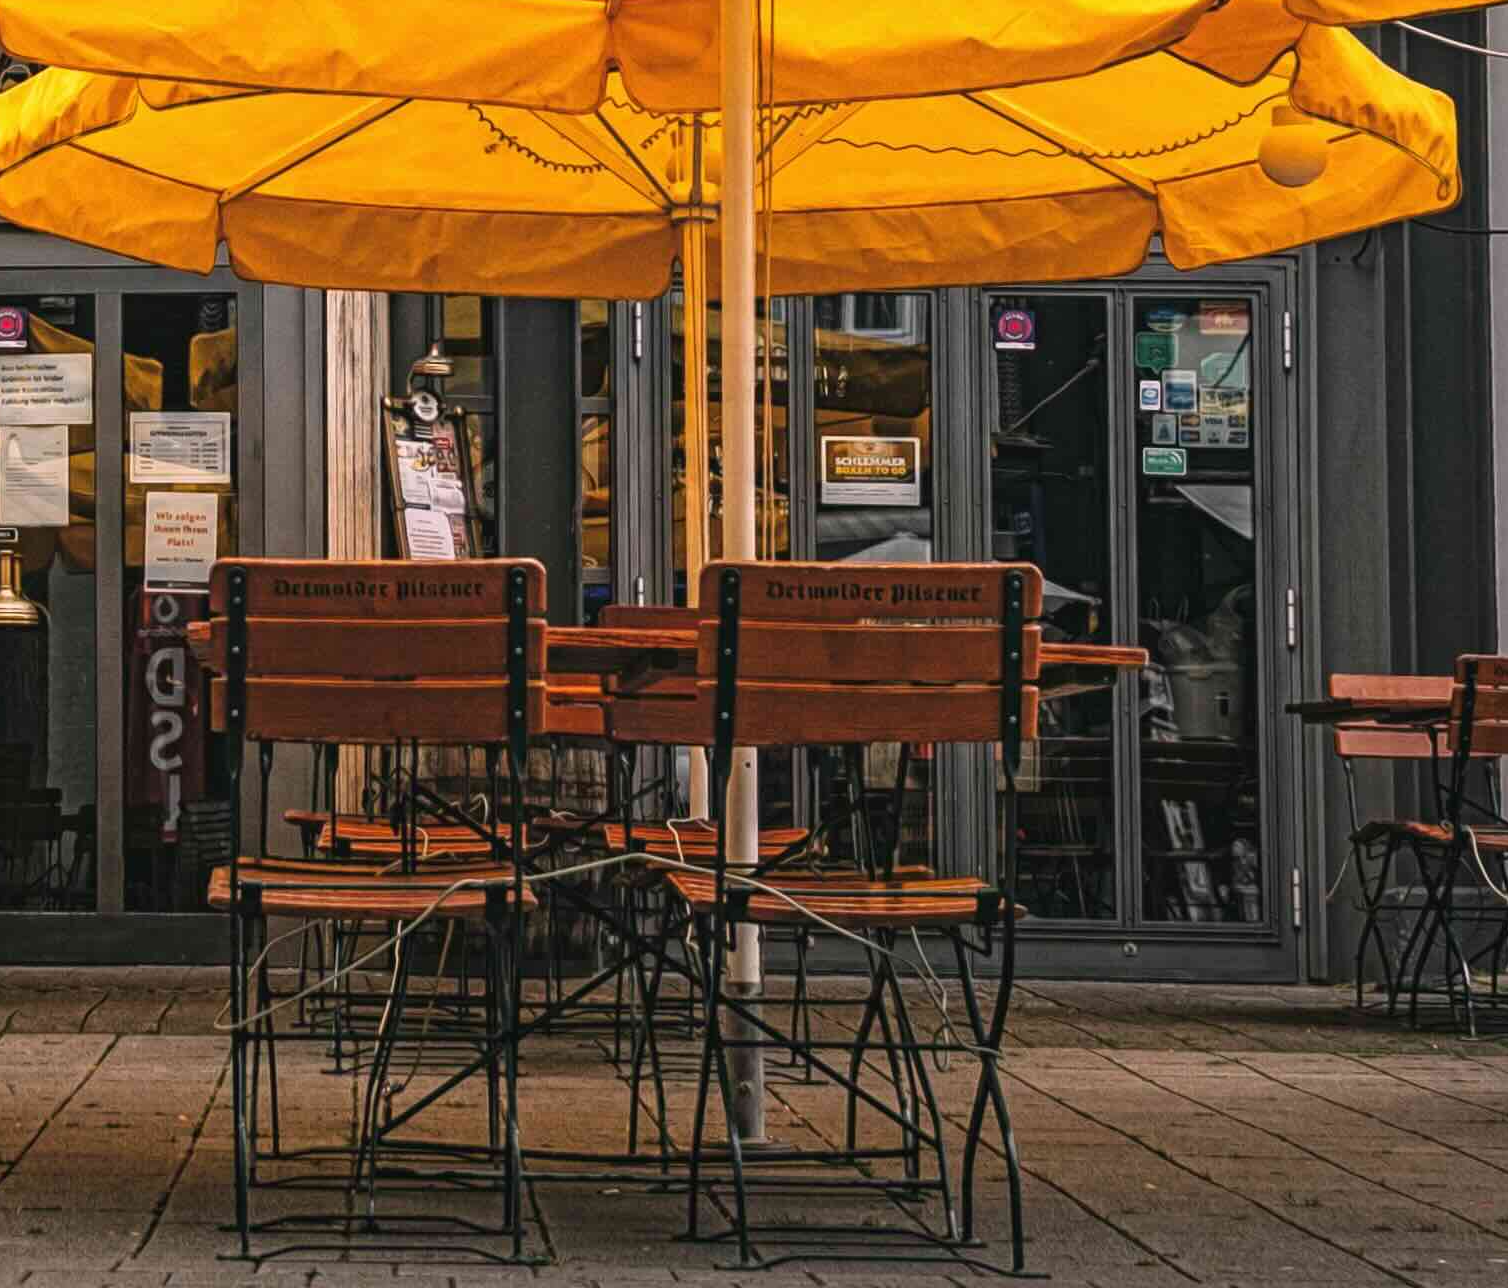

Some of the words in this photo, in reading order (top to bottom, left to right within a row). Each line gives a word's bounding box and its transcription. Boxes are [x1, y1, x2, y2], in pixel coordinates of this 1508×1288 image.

[835, 457, 906, 466] SCHLEMMER
[273, 578, 389, 599] Detmolder
[766, 579, 886, 601] Detmolder
[891, 582, 982, 605] Pilsener
